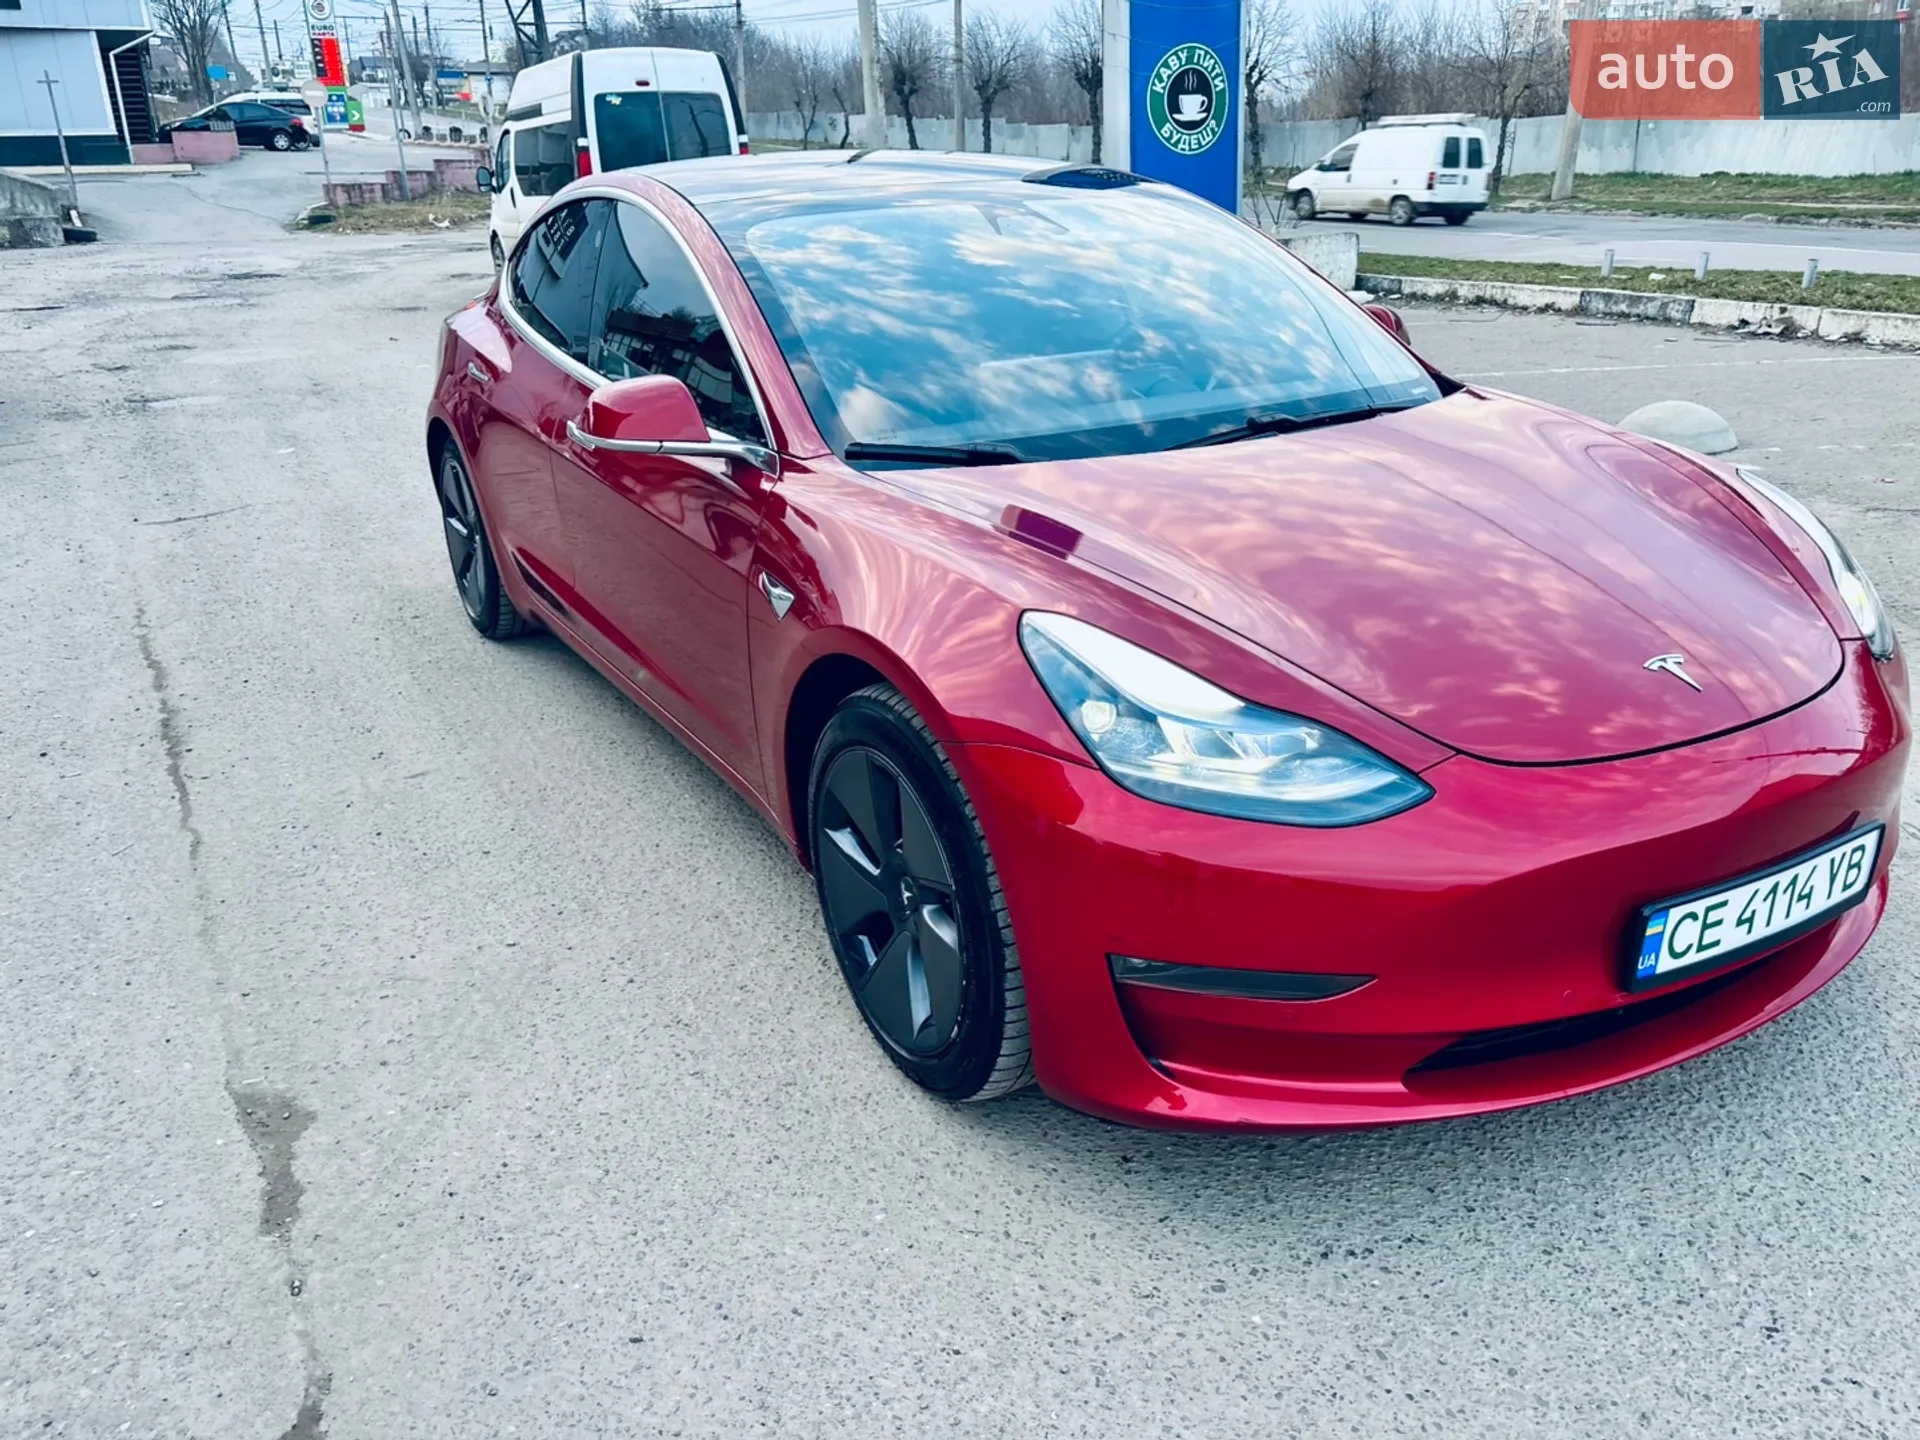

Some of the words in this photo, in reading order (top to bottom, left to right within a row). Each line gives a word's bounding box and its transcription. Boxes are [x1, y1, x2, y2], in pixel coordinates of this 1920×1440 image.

[1152, 48, 1188, 94] КАВУ
[1193, 49, 1225, 92] ПИТИ
[1160, 119, 1219, 152] БУДЕШ?
[1667, 898, 1729, 960] CE
[1735, 864, 1818, 935] 4114
[1826, 843, 1866, 900] YB
[1637, 954, 1655, 970] UA
